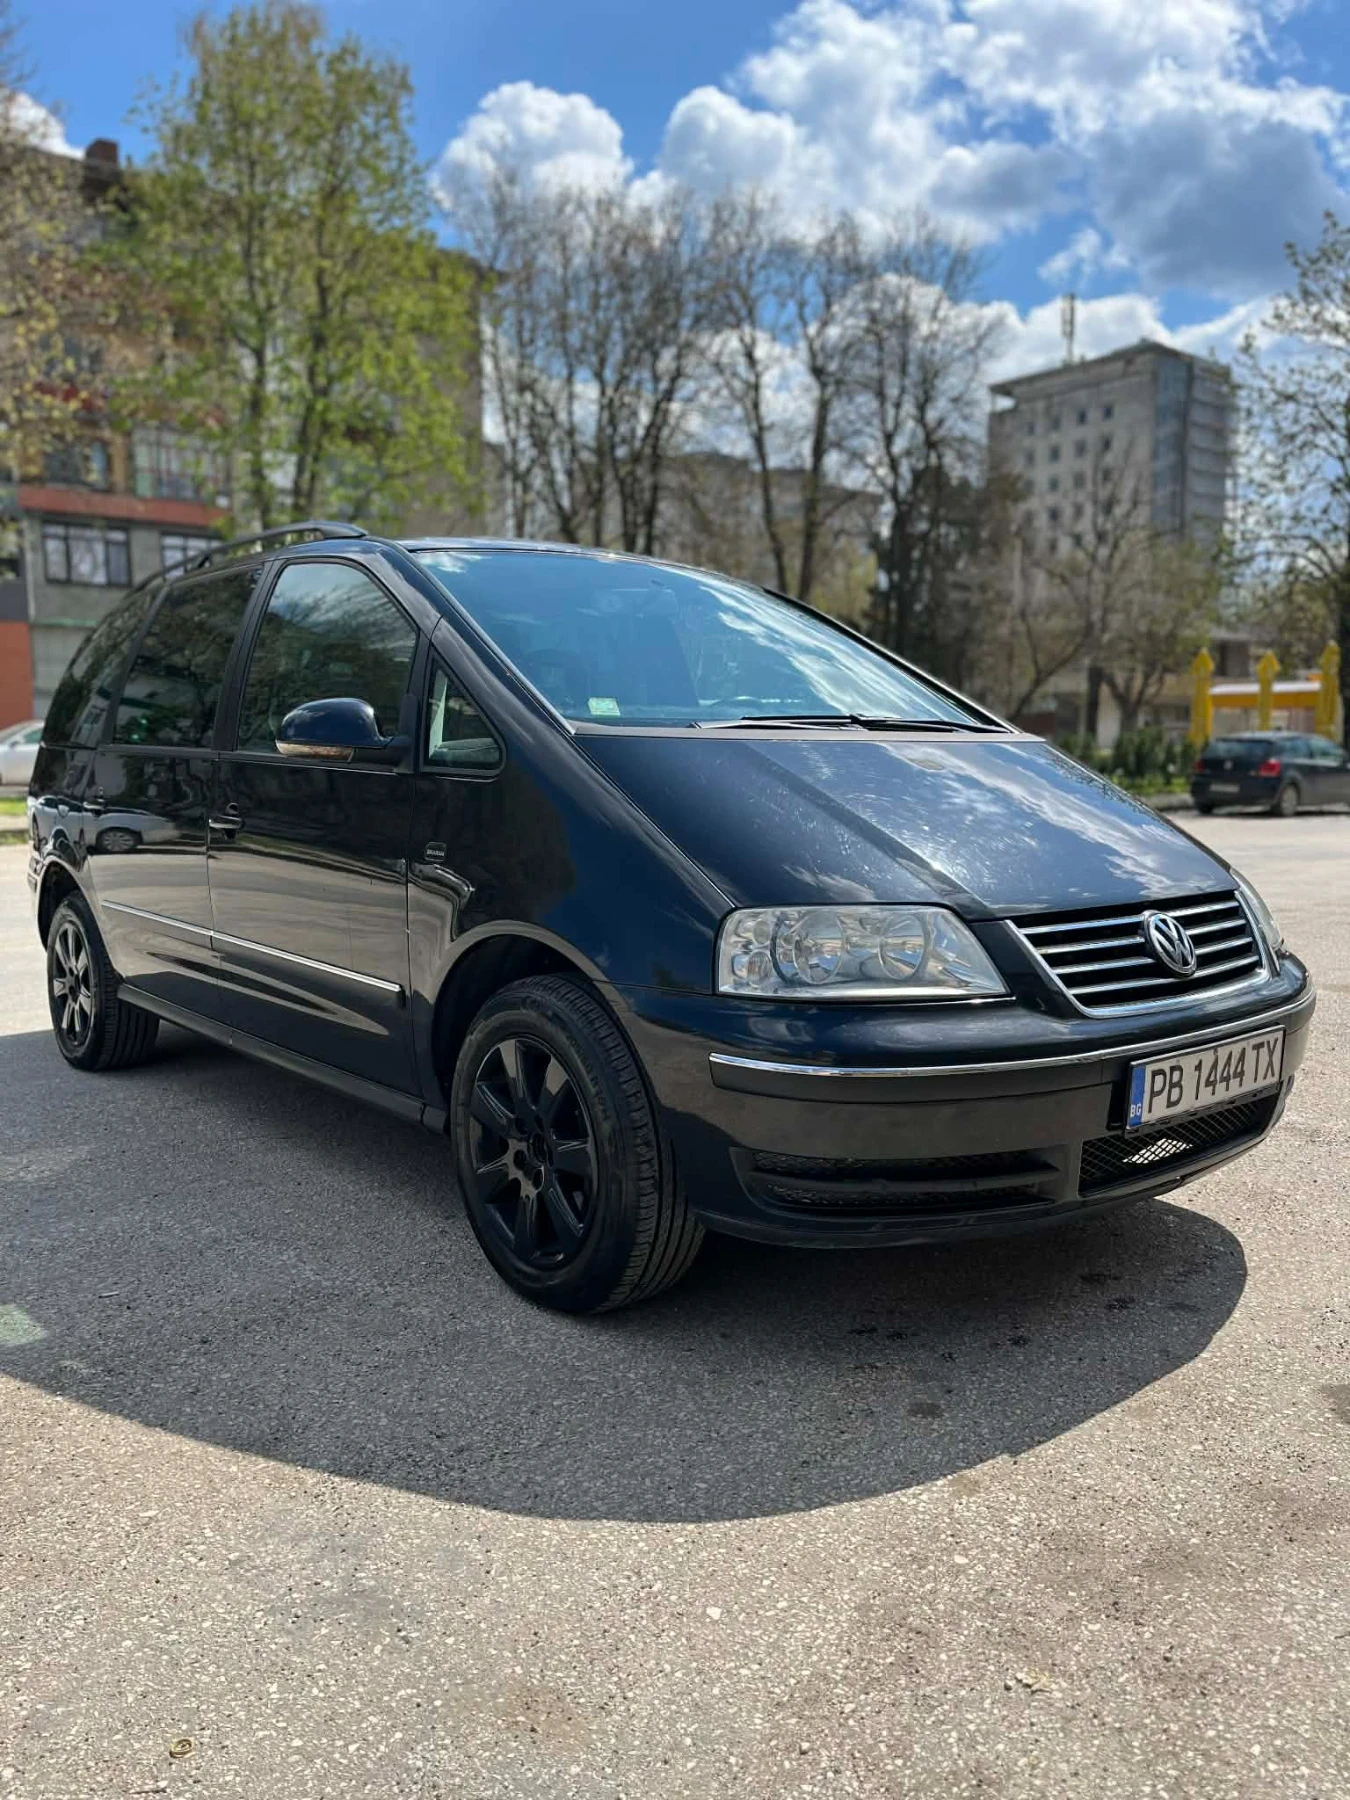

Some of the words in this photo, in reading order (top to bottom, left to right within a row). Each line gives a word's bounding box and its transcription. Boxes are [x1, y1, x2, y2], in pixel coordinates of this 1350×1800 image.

[1149, 912, 1196, 975] VW
[1147, 1064, 1184, 1114] PB
[1194, 1047, 1247, 1101] 1444
[1251, 1036, 1279, 1084] TX
[1130, 1103, 1142, 1118] BG
